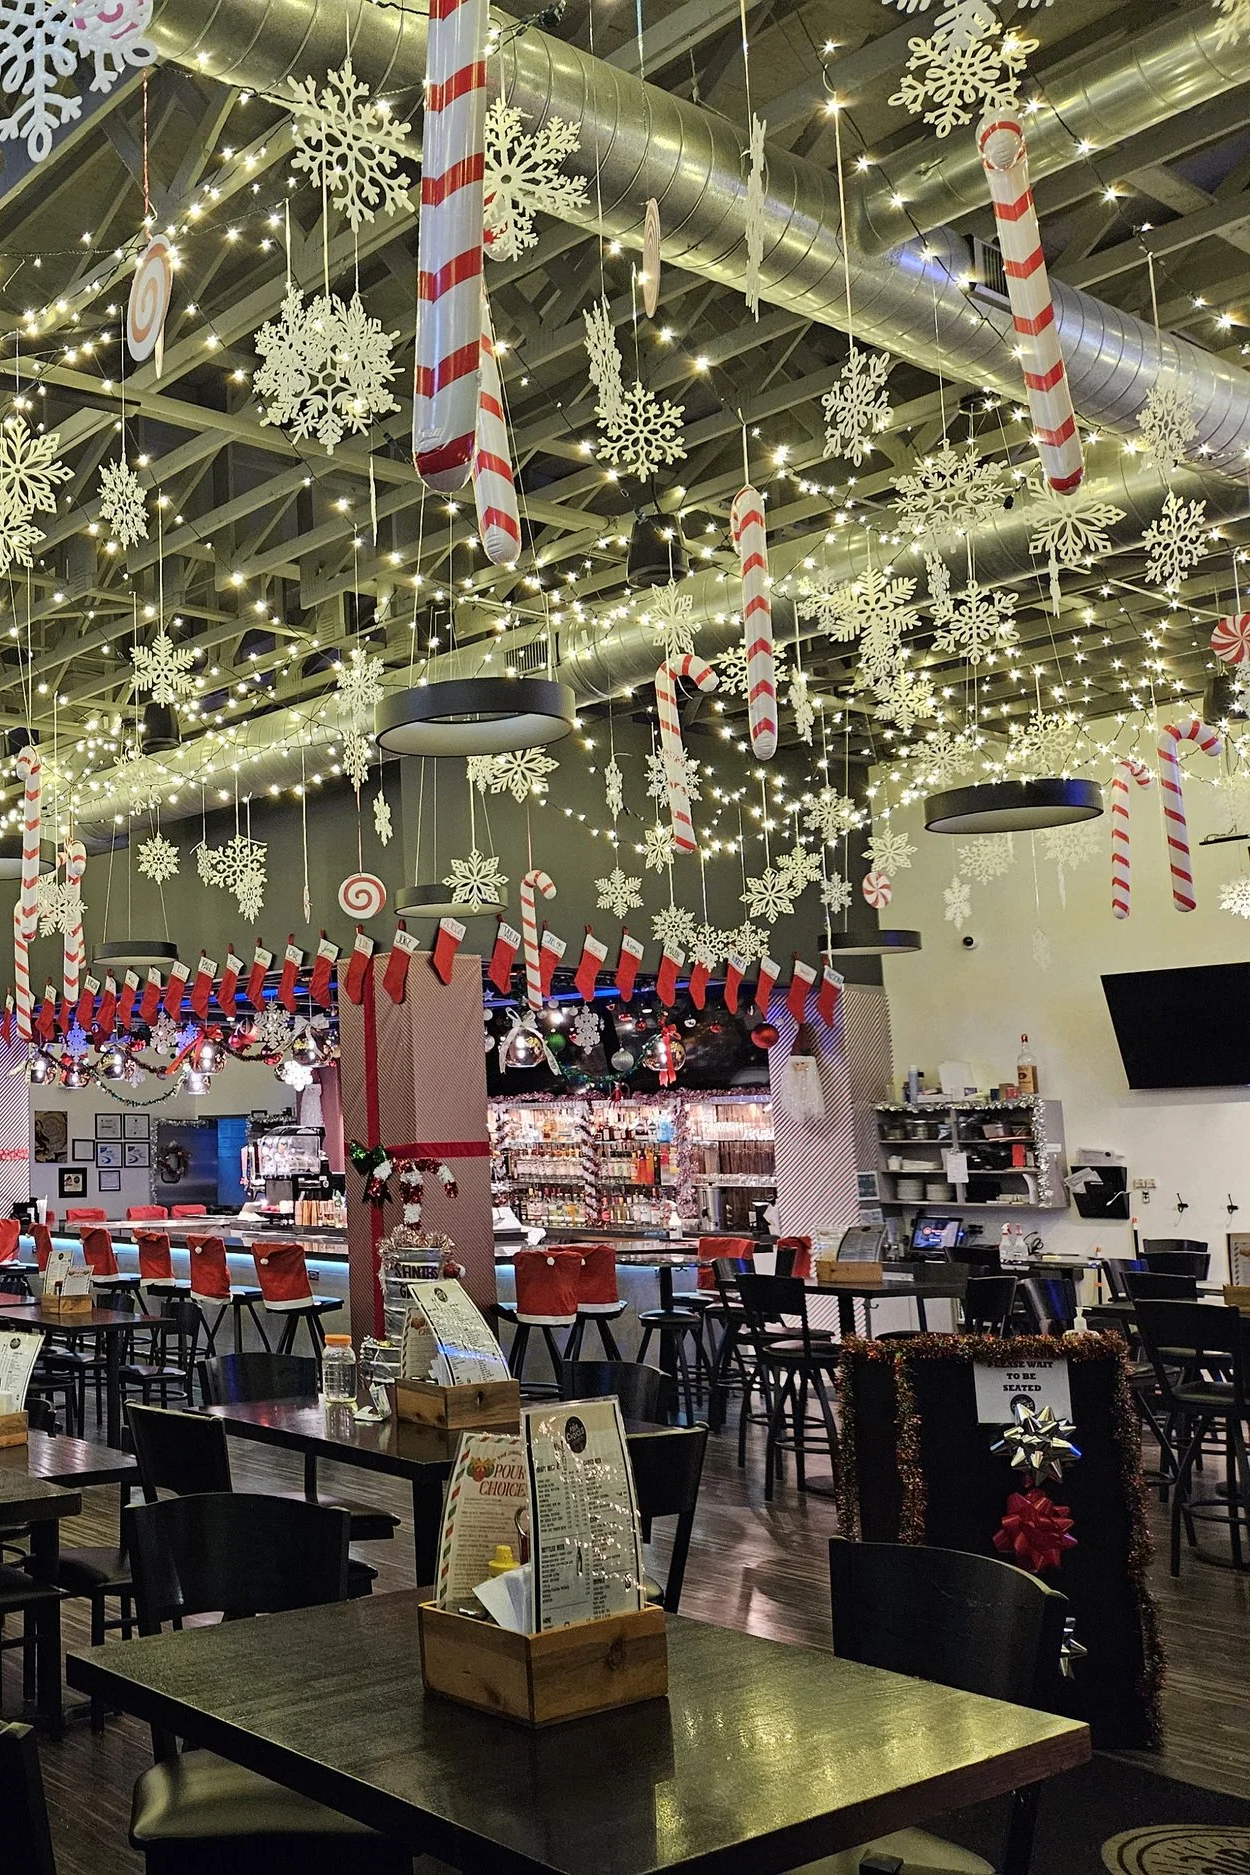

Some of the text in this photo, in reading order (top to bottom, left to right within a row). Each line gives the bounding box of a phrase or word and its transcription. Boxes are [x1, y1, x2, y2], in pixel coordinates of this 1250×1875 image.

[1027, 1360, 1054, 1368] WAIT
[1006, 1372, 1037, 1380] TO BE
[1002, 1384, 1042, 1392] SEATED
